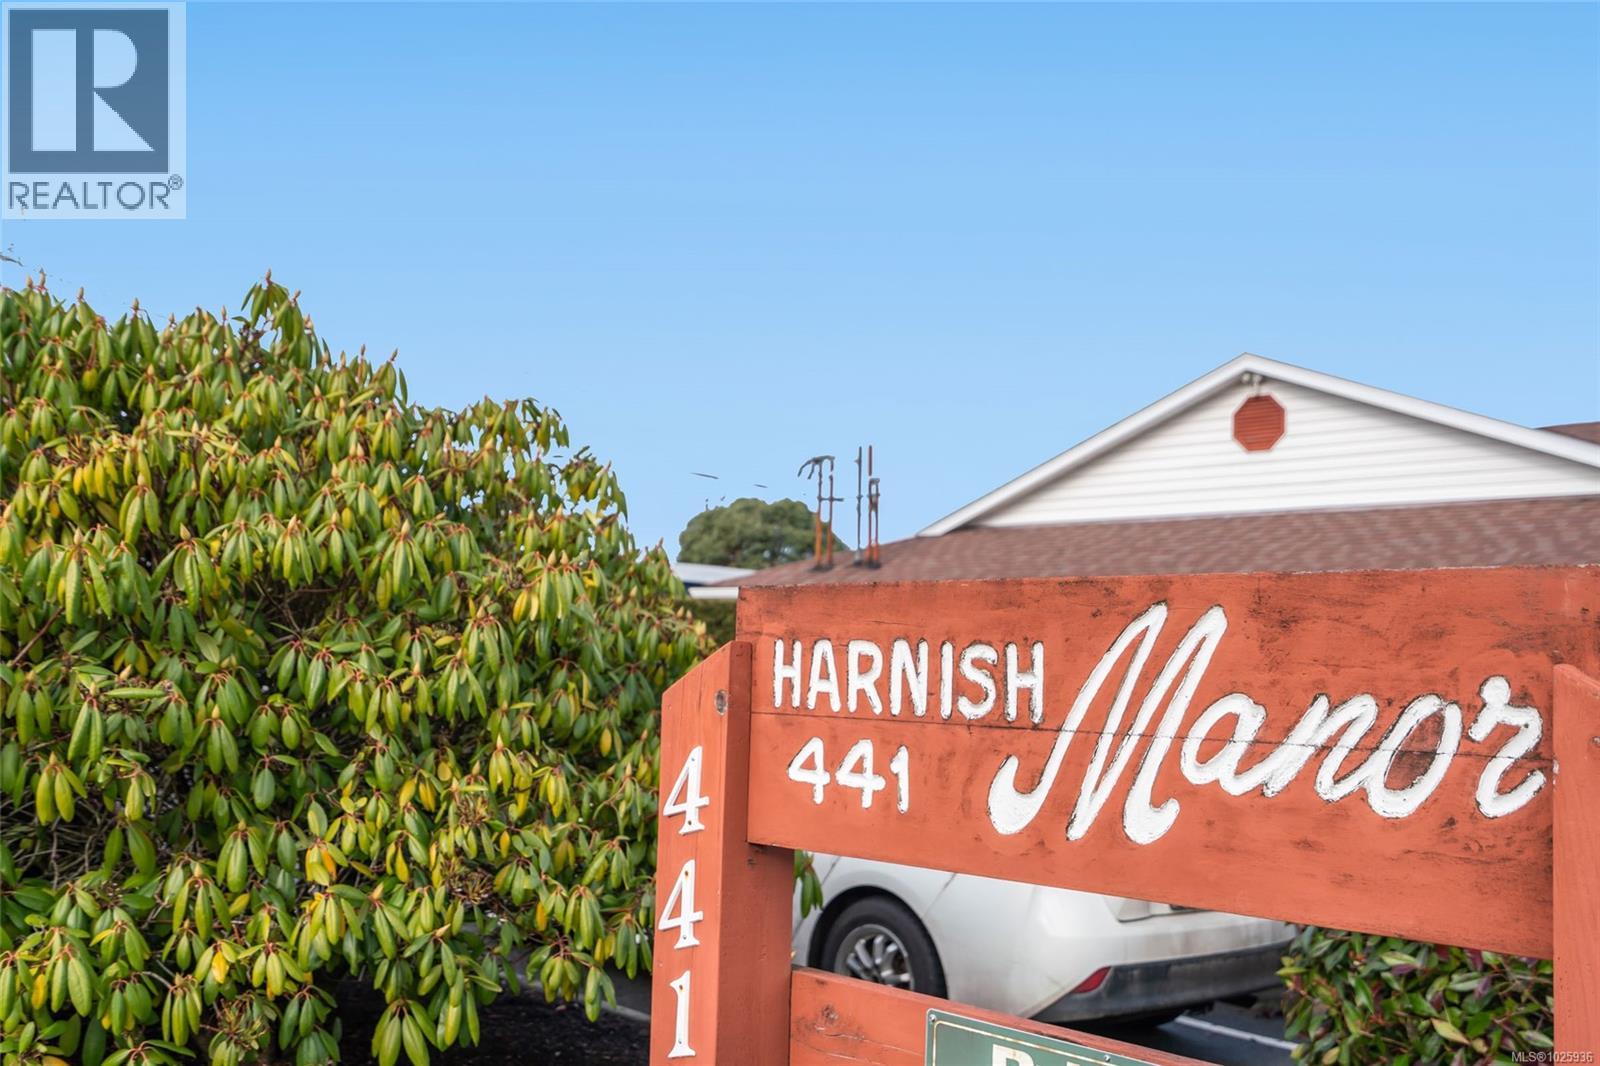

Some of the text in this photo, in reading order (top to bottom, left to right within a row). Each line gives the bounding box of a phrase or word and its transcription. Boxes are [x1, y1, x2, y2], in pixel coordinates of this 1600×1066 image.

[773, 602, 1547, 845] HARNISH Manor
[787, 736, 911, 814] 441
[658, 745, 710, 1058] 441
